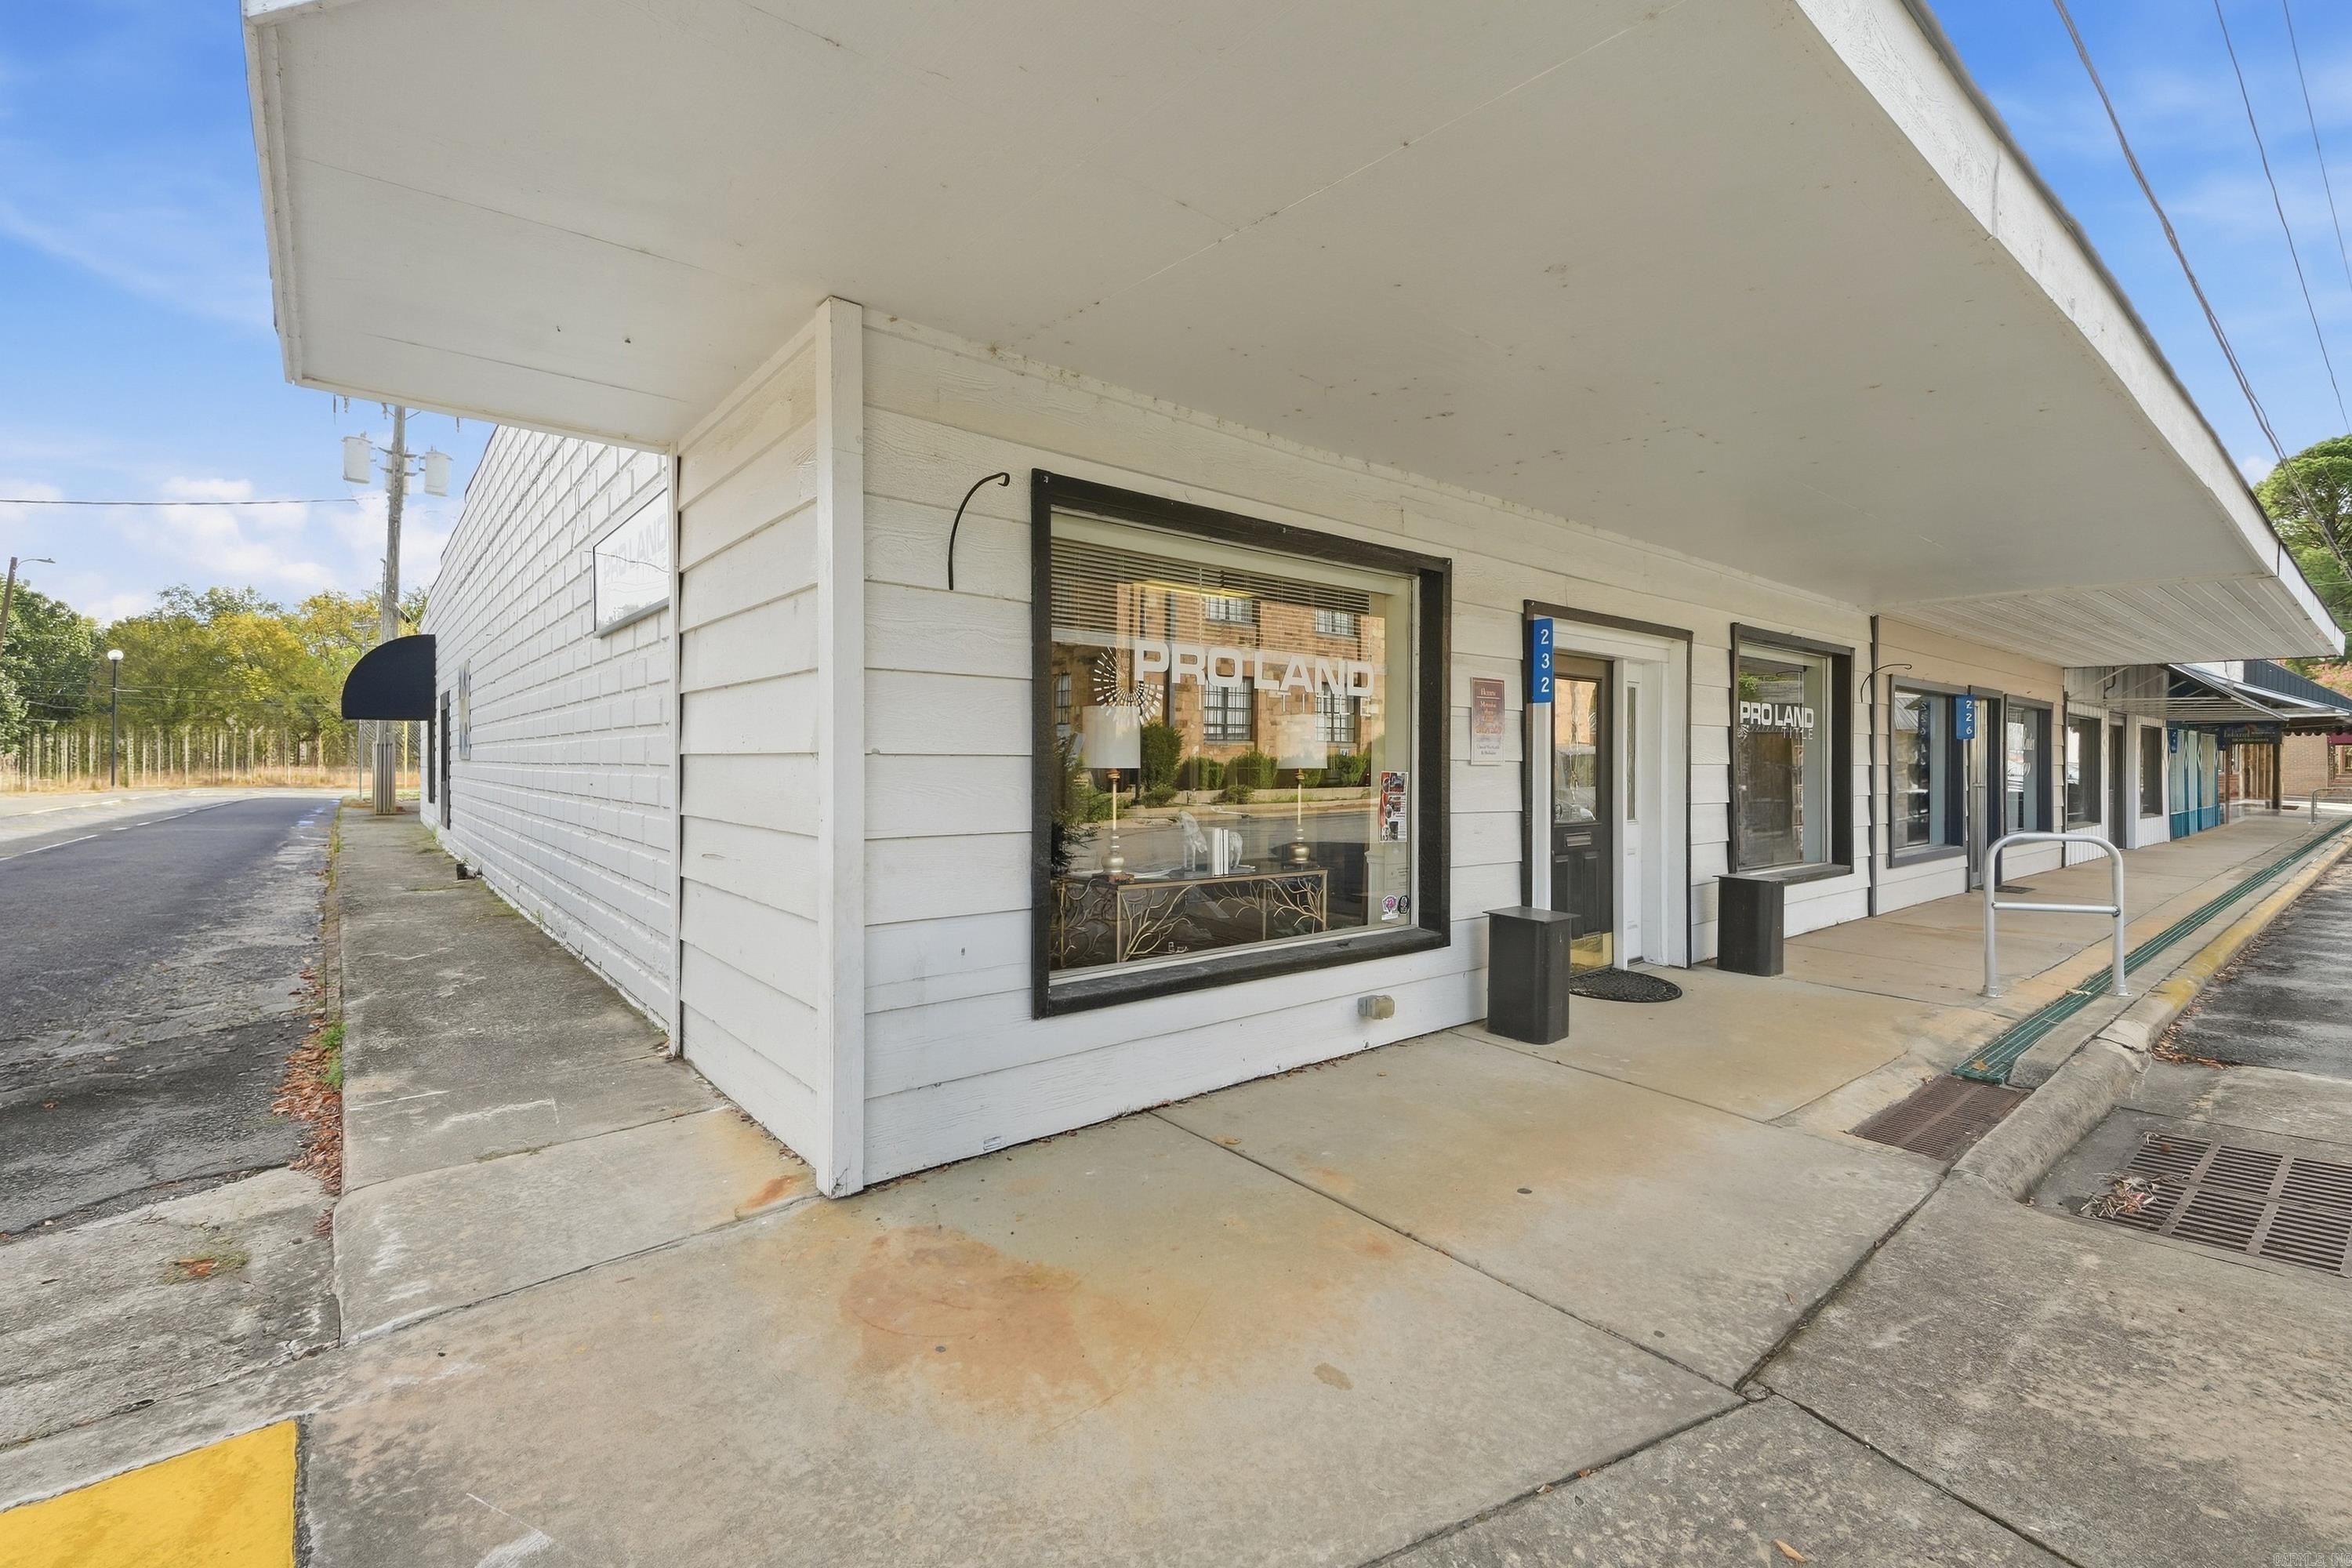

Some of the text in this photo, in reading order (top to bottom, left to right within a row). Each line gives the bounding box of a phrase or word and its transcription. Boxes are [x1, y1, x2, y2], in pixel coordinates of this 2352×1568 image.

[1134, 639, 1374, 697] PRO LAND
[1541, 629, 1551, 693] 232
[1276, 691, 1373, 717] TITLE
[1740, 700, 1814, 728] PRO LAND
[1781, 726, 1813, 740] TITLE
